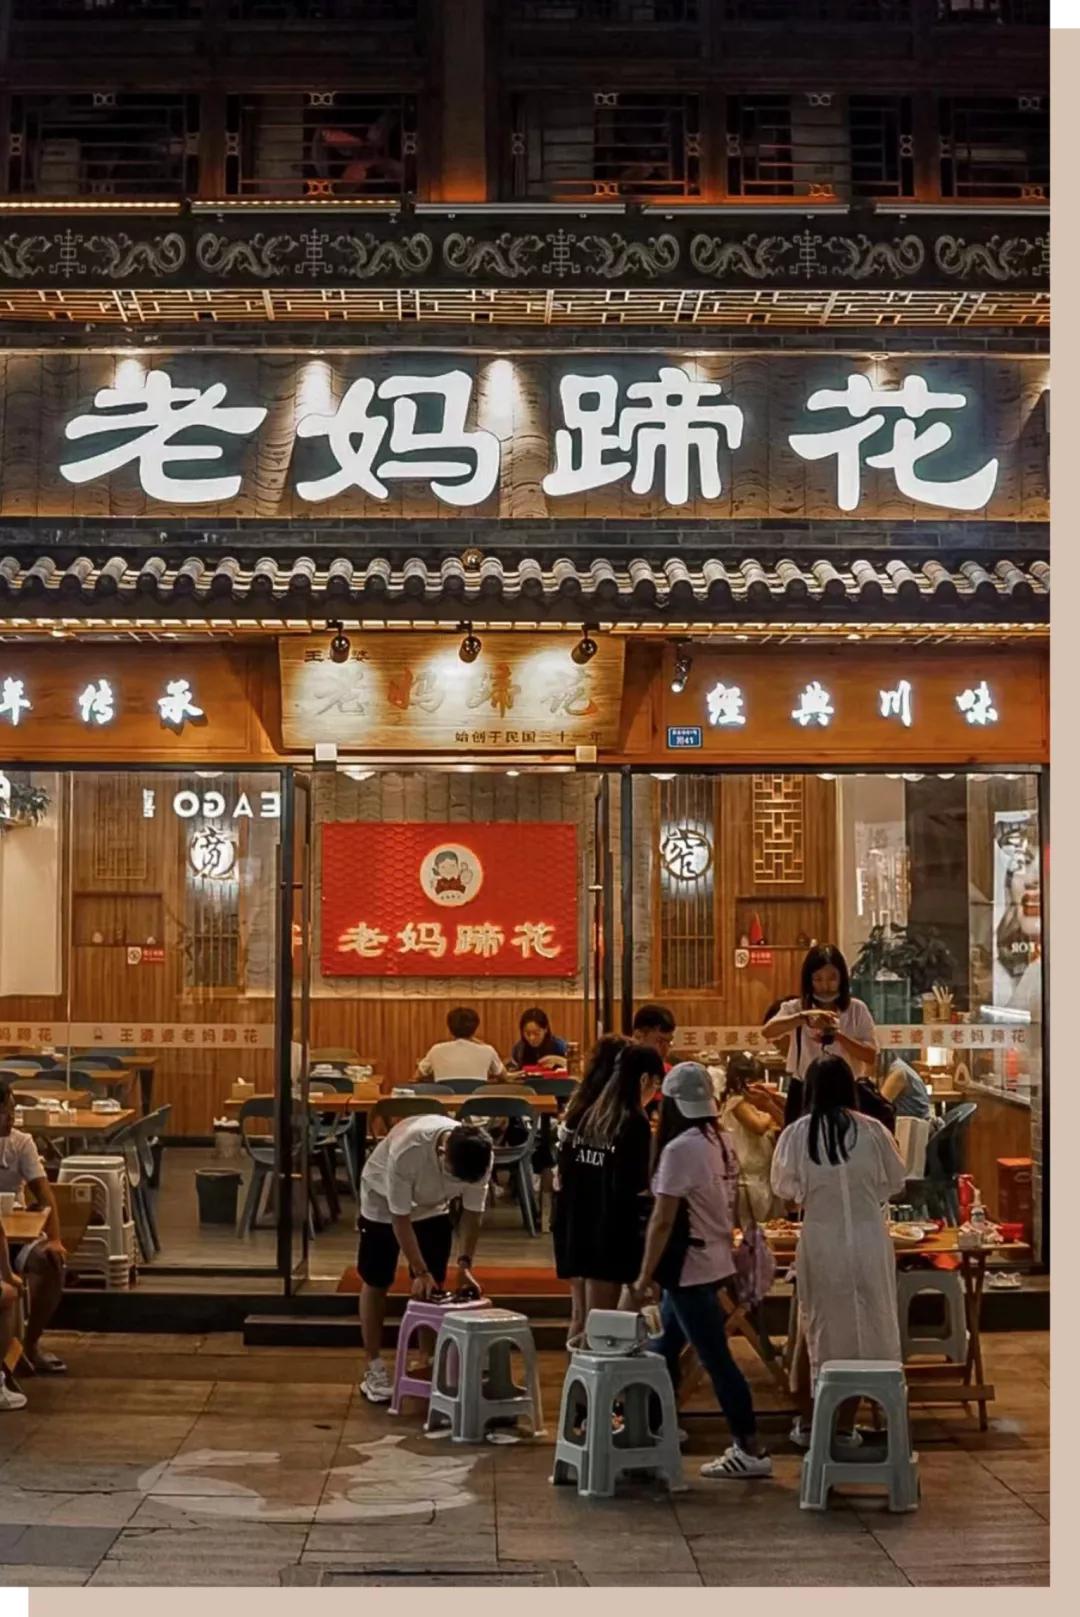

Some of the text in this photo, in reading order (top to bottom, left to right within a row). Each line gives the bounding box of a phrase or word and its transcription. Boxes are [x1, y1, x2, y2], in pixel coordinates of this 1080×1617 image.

[59, 369, 998, 510] 老妈蹄花
[337, 921, 562, 959] 老妈蹄花
